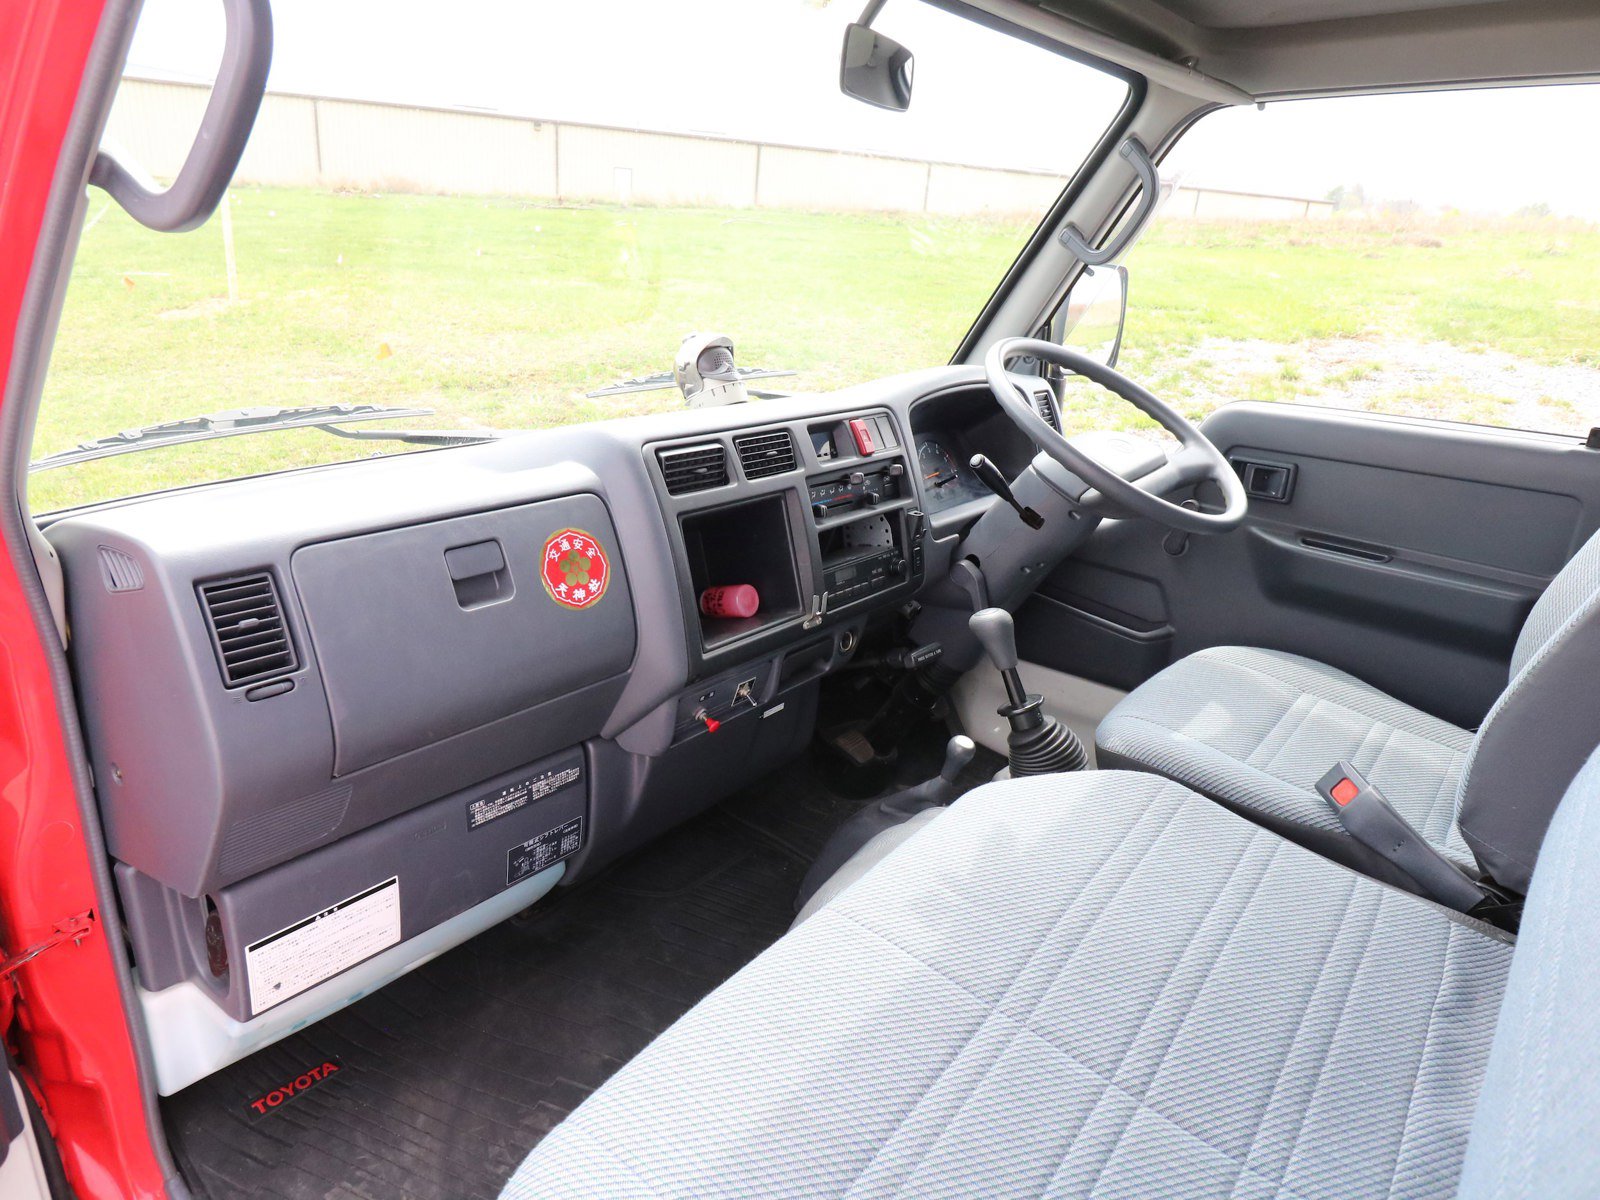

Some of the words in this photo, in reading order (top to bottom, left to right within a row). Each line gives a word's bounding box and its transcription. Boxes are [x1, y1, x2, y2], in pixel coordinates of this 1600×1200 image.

[549, 538, 596, 562] 交通安全
[251, 1062, 339, 1114] TOYOTA
